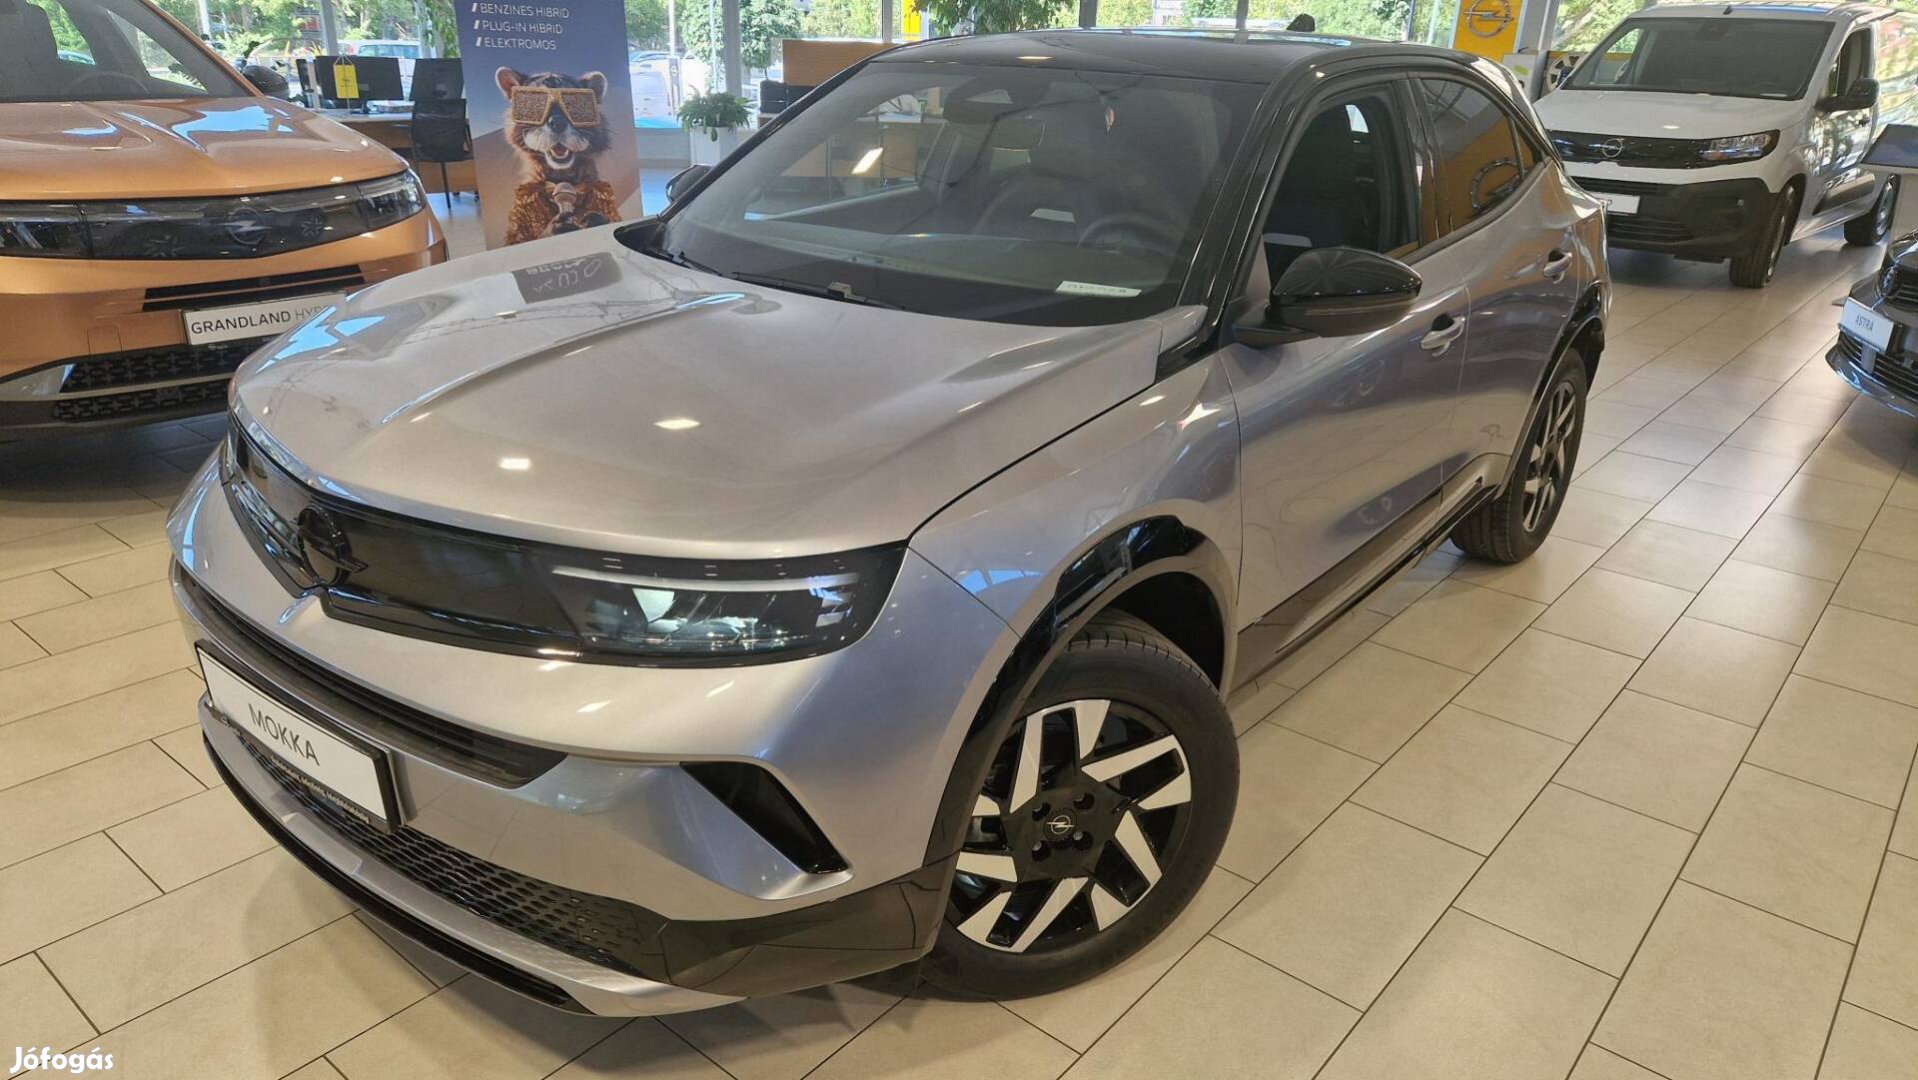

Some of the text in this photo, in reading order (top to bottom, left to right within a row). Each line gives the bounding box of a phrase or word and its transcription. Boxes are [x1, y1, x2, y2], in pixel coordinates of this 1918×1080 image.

[480, 3, 570, 18] BENZINES HIBRID
[482, 20, 563, 34] PLUG-IN HIBRID
[484, 37, 557, 50] ELEKTROMOS
[191, 310, 291, 334] GRANDLAND
[1856, 314, 1874, 332] ASTRA
[248, 703, 320, 766] MOKKA
